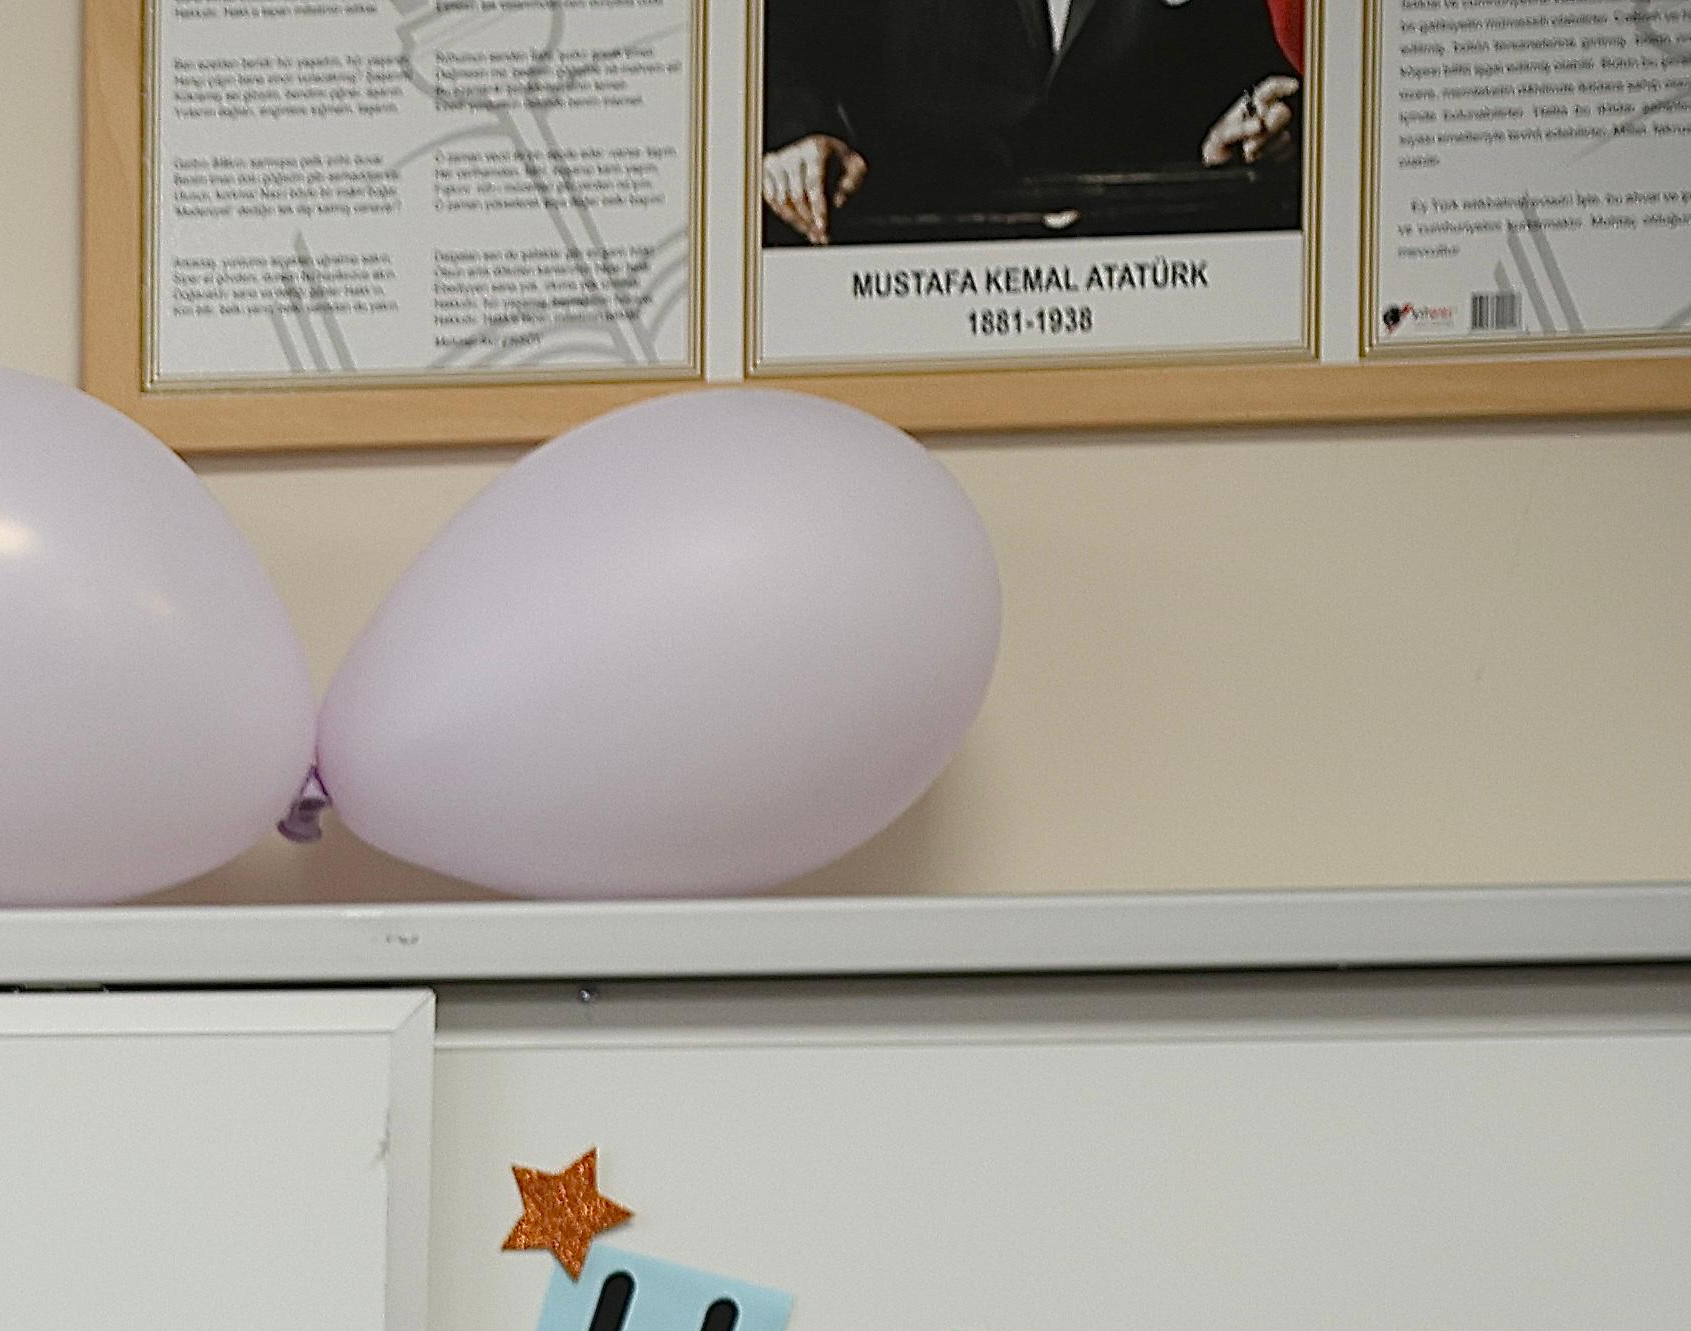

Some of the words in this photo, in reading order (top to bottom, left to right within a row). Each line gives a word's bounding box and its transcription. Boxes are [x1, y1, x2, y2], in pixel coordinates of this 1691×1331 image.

[852, 267, 978, 298] MUSTAFA
[984, 264, 1079, 295] KEMAL
[1085, 255, 1209, 292] ATATÜRK
[968, 305, 1094, 337] 1881-1938
